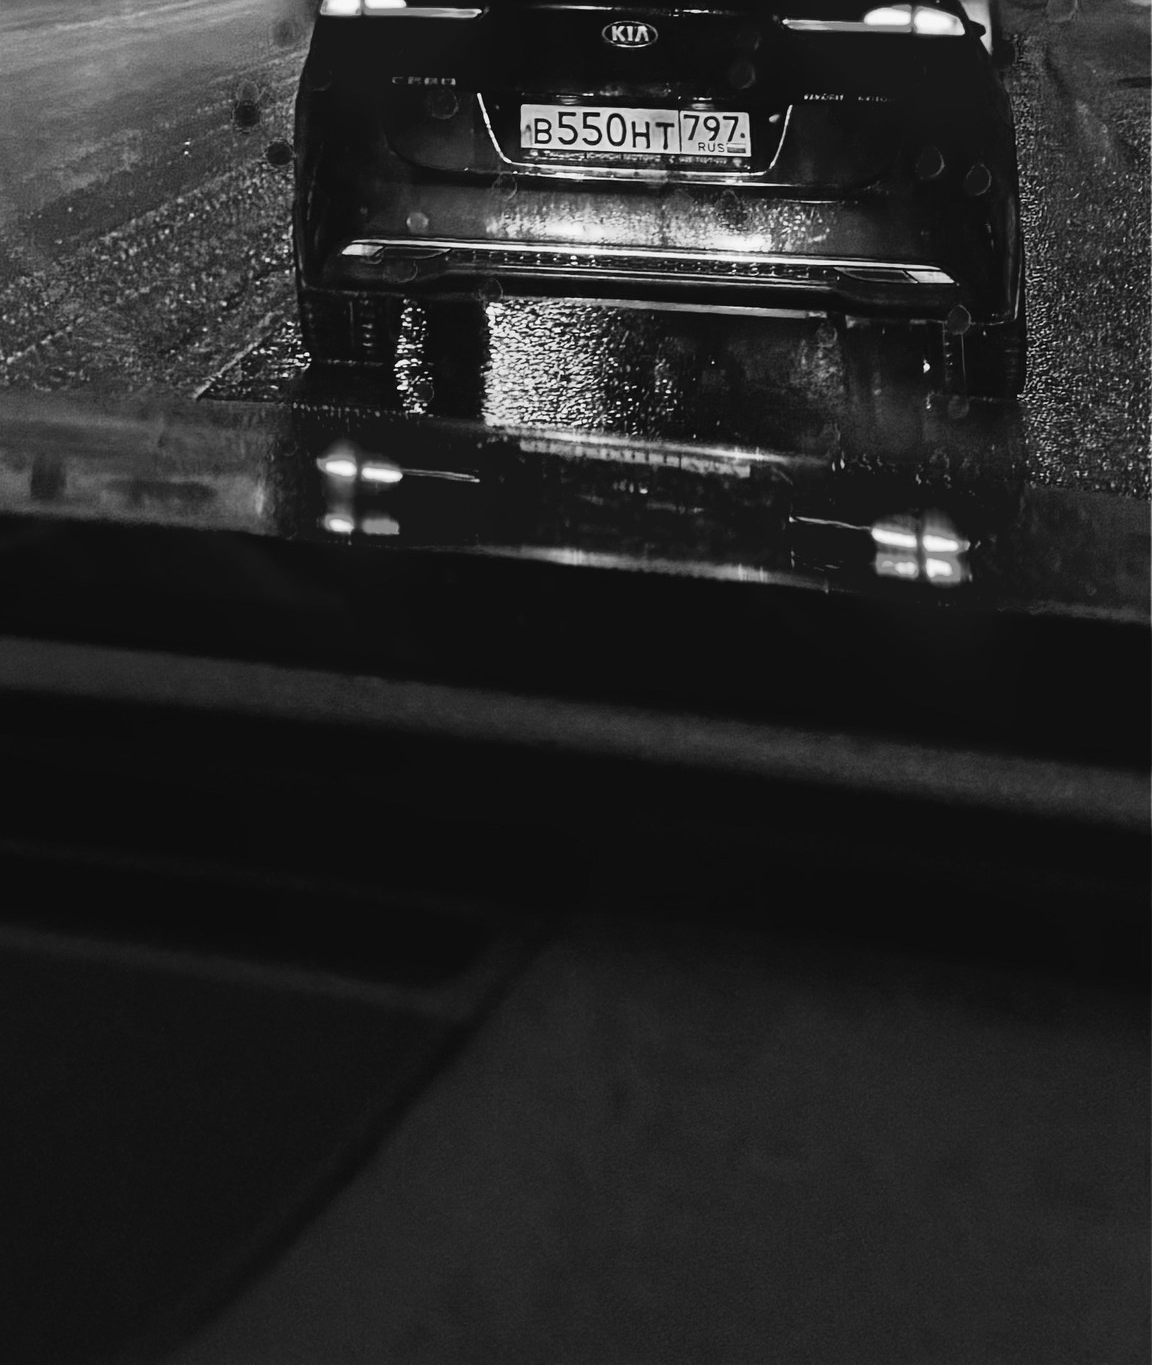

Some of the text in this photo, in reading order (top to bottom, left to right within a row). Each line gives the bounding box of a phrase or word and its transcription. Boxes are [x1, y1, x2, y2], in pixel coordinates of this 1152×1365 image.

[611, 25, 650, 43] KIA
[682, 113, 740, 143] 797
[697, 142, 725, 153] RUS
